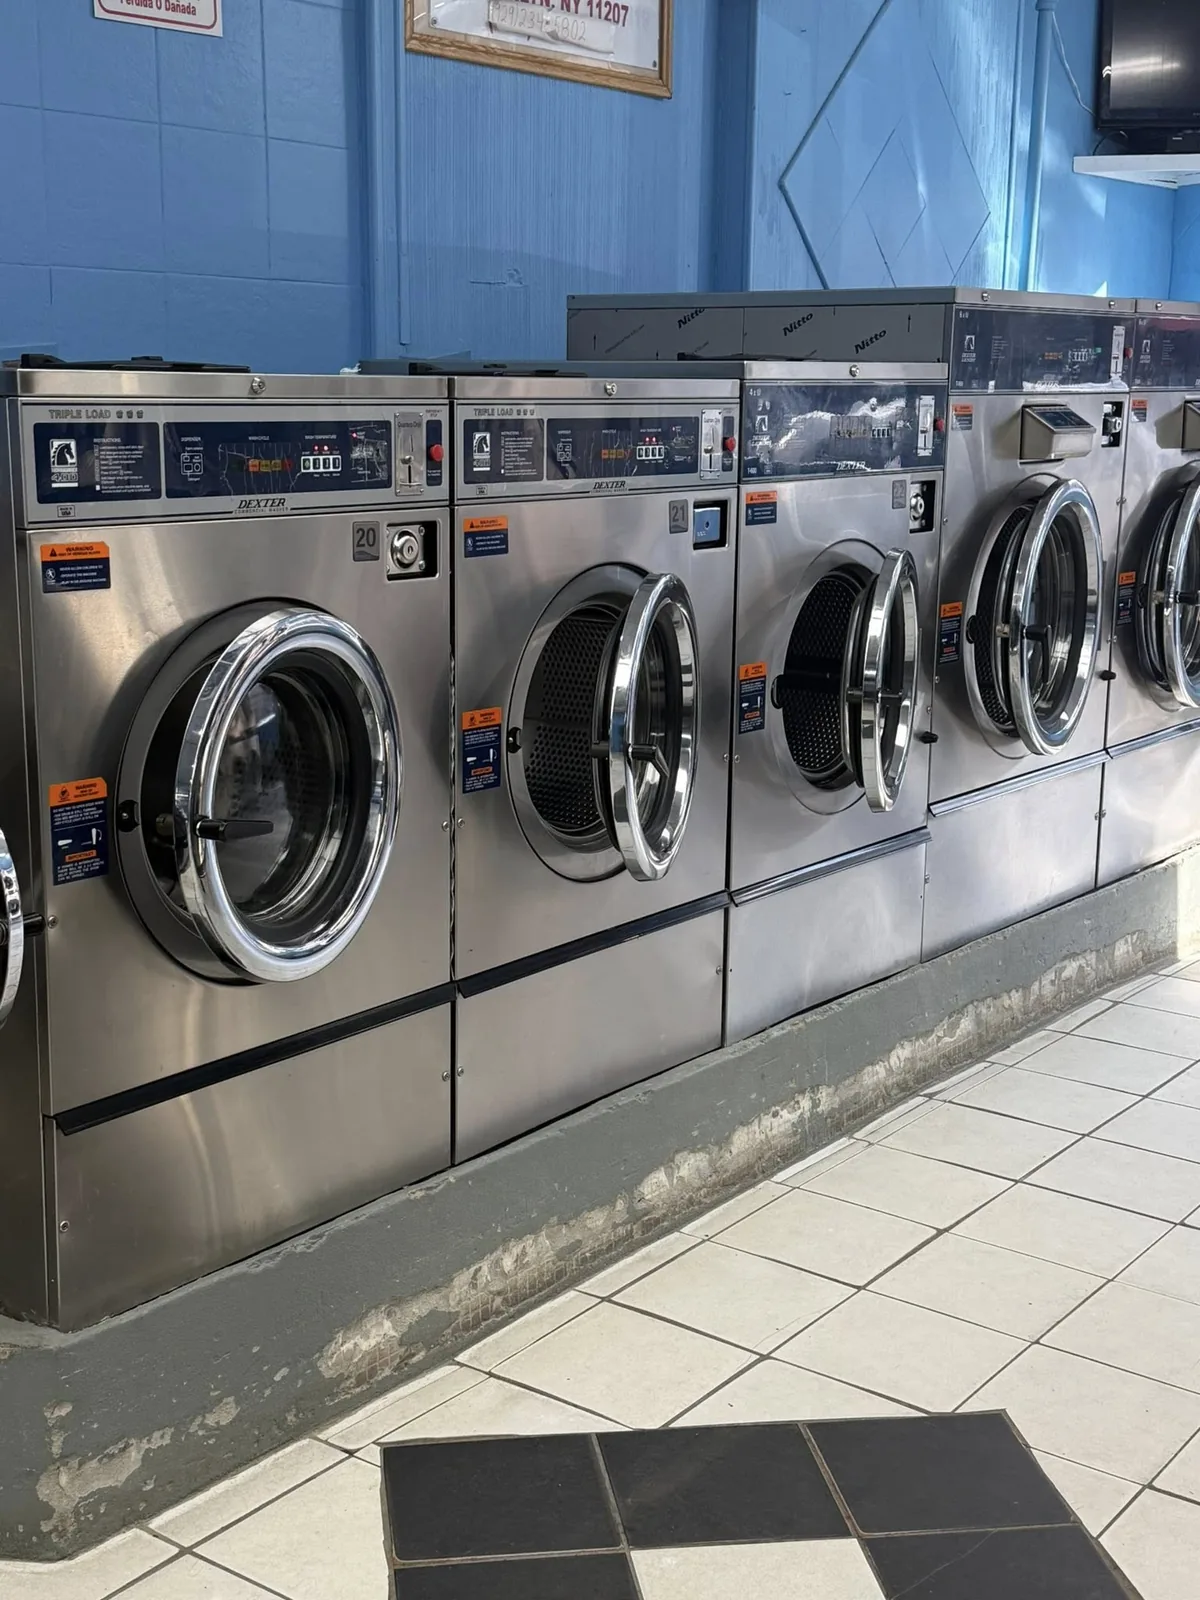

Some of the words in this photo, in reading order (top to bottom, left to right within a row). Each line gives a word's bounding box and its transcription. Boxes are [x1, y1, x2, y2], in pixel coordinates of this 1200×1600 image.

[120, 0, 153, 9] erdida
[165, 0, 197, 16] Dañada
[560, 0, 580, 14] NY
[587, 0, 629, 27] 11207
[677, 307, 706, 329] Nitto
[782, 312, 814, 336] Nitto
[854, 328, 887, 354] Nitto
[48, 409, 82, 419] TRIPLE
[85, 409, 111, 419] LOAD
[473, 408, 495, 417] TRIPLE
[497, 408, 514, 416] LOAD
[593, 480, 626, 489] DEXTER
[237, 498, 286, 509] DEXTER
[672, 505, 685, 523] 21
[356, 527, 376, 548] 20
